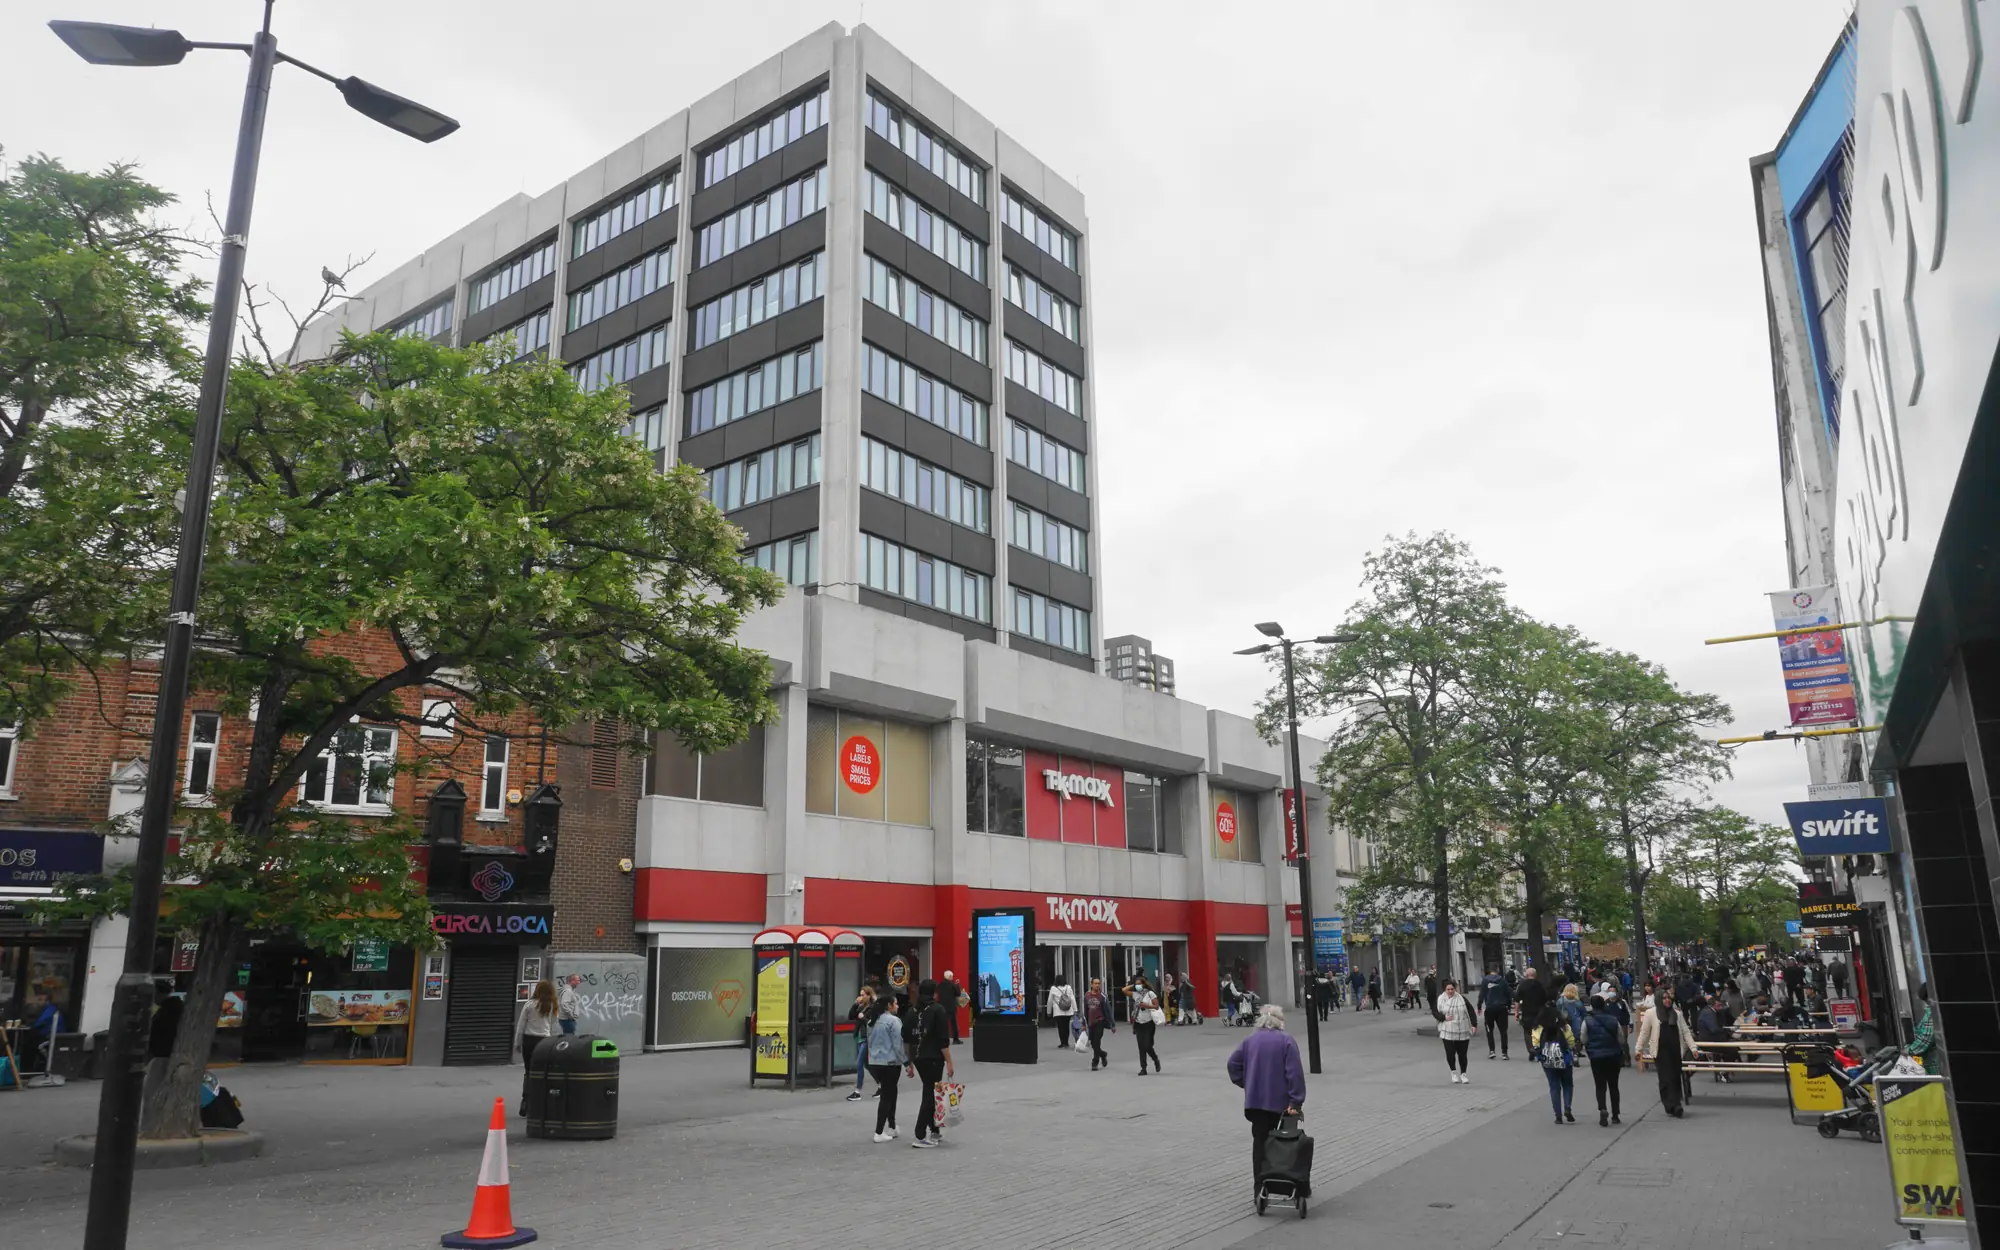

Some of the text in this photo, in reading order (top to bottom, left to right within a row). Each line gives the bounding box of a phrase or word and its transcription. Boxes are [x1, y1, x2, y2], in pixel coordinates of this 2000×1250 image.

[856, 744, 866, 754] BIG
[850, 752, 871, 765] LABELS
[851, 764, 870, 776] SMALL
[850, 774, 871, 785] PRICES
[1816, 783, 1859, 793] HAMPTONS
[1802, 810, 1879, 838] swift
[1801, 904, 1832, 915] MARKET
[431, 914, 548, 934] CIRCA LOCA
[672, 992, 707, 1001] DISCOVER
[707, 992, 713, 1000] A
[759, 1040, 787, 1054] swift
[1883, 1083, 1898, 1095] NOW
[1883, 1088, 1901, 1102] OPEN
[1891, 1117, 1912, 1127] Your
